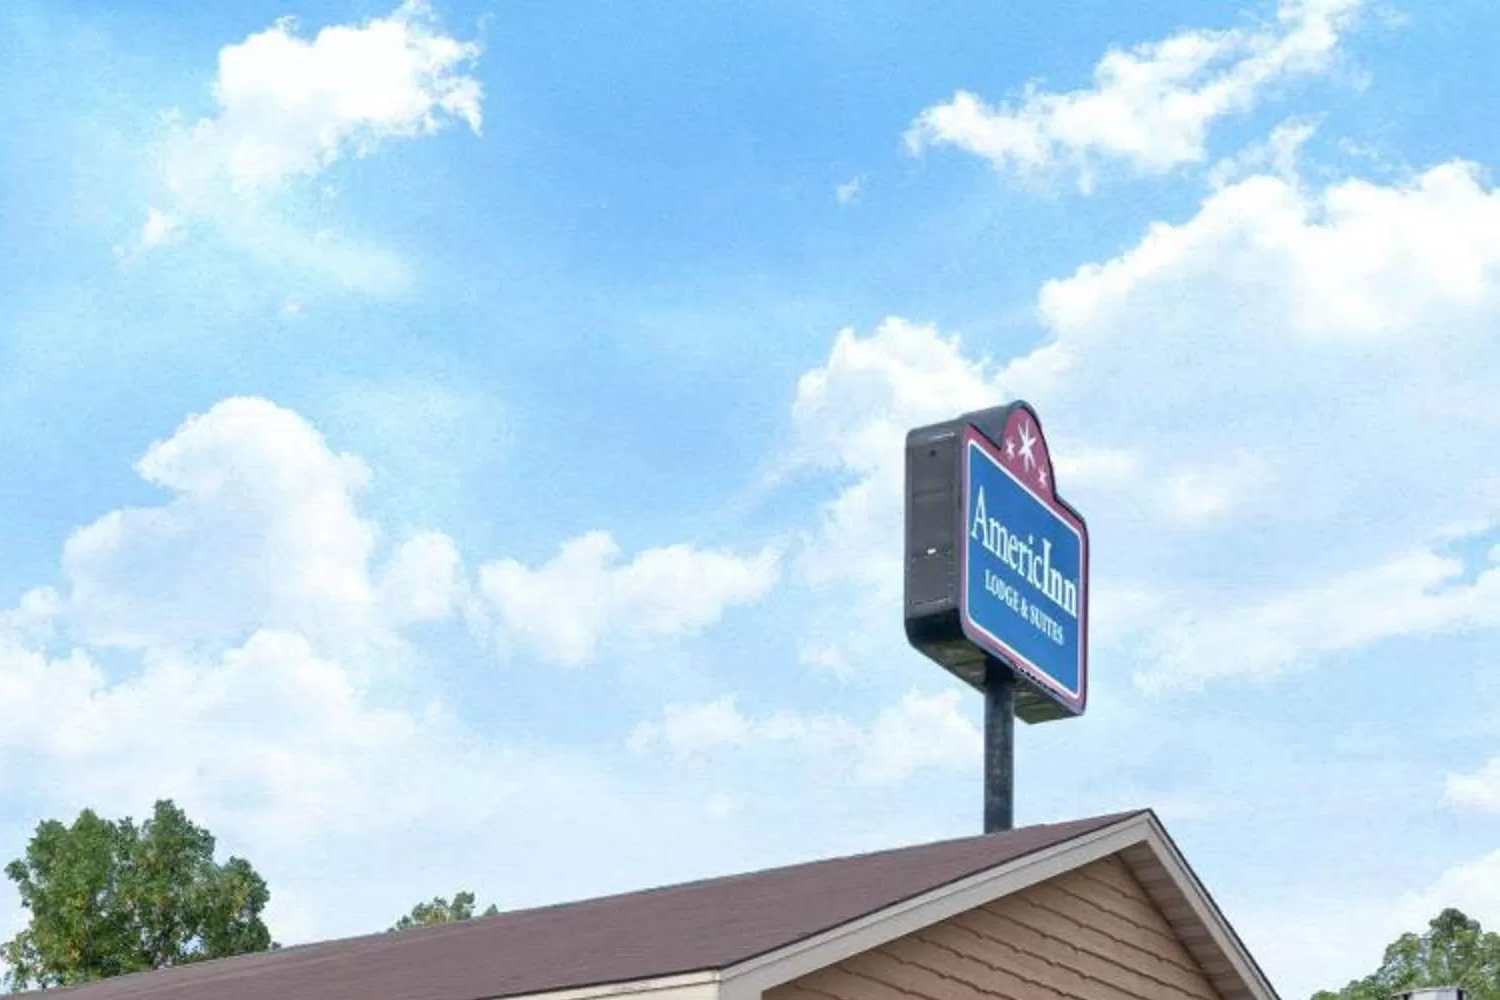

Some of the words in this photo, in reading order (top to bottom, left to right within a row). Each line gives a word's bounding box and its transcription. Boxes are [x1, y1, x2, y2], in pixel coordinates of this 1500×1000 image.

[971, 484, 1077, 619] AmericInn
[985, 568, 1019, 613] LODGE
[1021, 597, 1029, 621] &
[1029, 604, 1064, 646] SUITES
